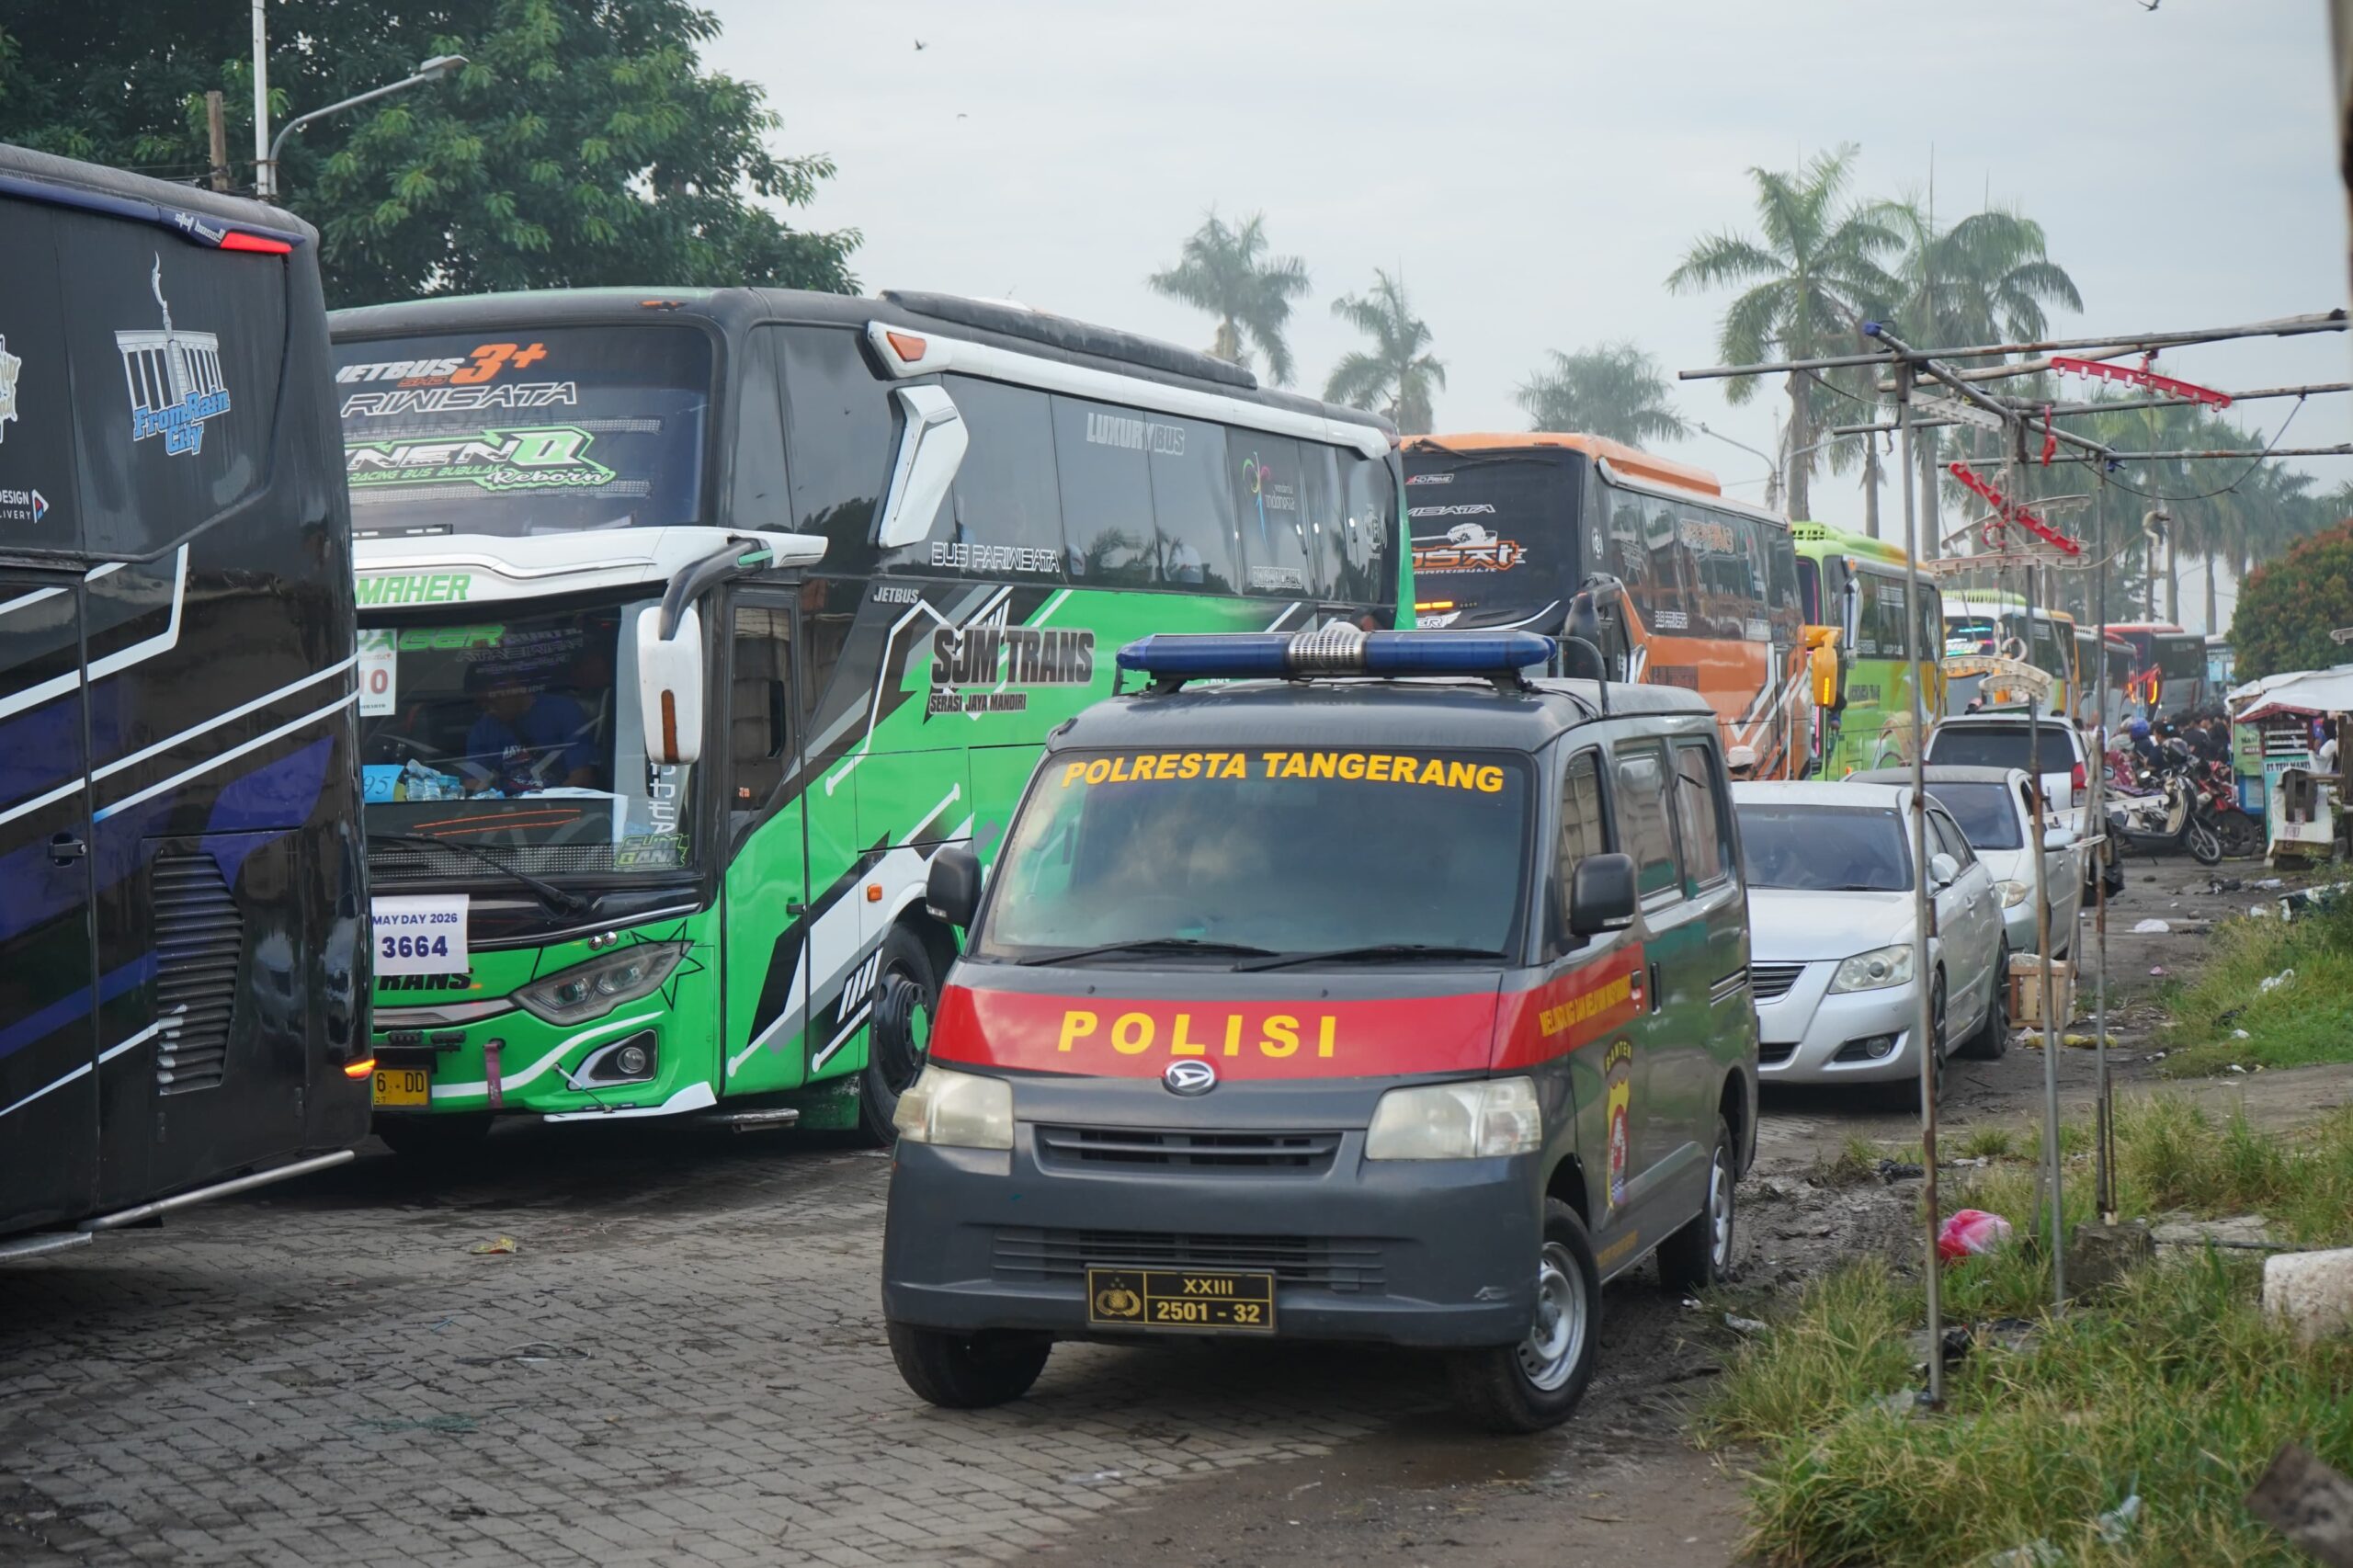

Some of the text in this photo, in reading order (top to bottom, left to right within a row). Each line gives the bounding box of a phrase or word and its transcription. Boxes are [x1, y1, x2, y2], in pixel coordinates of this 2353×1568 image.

[449, 343, 549, 385] 3+
[133, 386, 231, 442] From Rain
[165, 419, 204, 456] City
[1086, 412, 1185, 456] LUXURY BUS
[347, 469, 400, 483] RACING
[402, 467, 432, 479] BUS
[486, 469, 610, 487] Reborn
[932, 541, 1060, 574] BUS PARIWISATA
[873, 586, 919, 604] JETBUS
[931, 625, 1095, 688] SJM TRANS
[929, 692, 1027, 713] SERASI JAYA MANDIRI
[1061, 752, 1505, 794] POLRESTA TANGERANG
[429, 913, 458, 924] 2026
[381, 935, 449, 959] 3664
[371, 968, 474, 991] RANS
[1057, 1010, 1337, 1059] POLISI
[1605, 1040, 1632, 1073] BANTEN
[405, 1073, 425, 1093] DD
[1183, 1278, 1234, 1295] XXIII
[1156, 1301, 1209, 1322] 2501
[1233, 1303, 1261, 1324] 32
